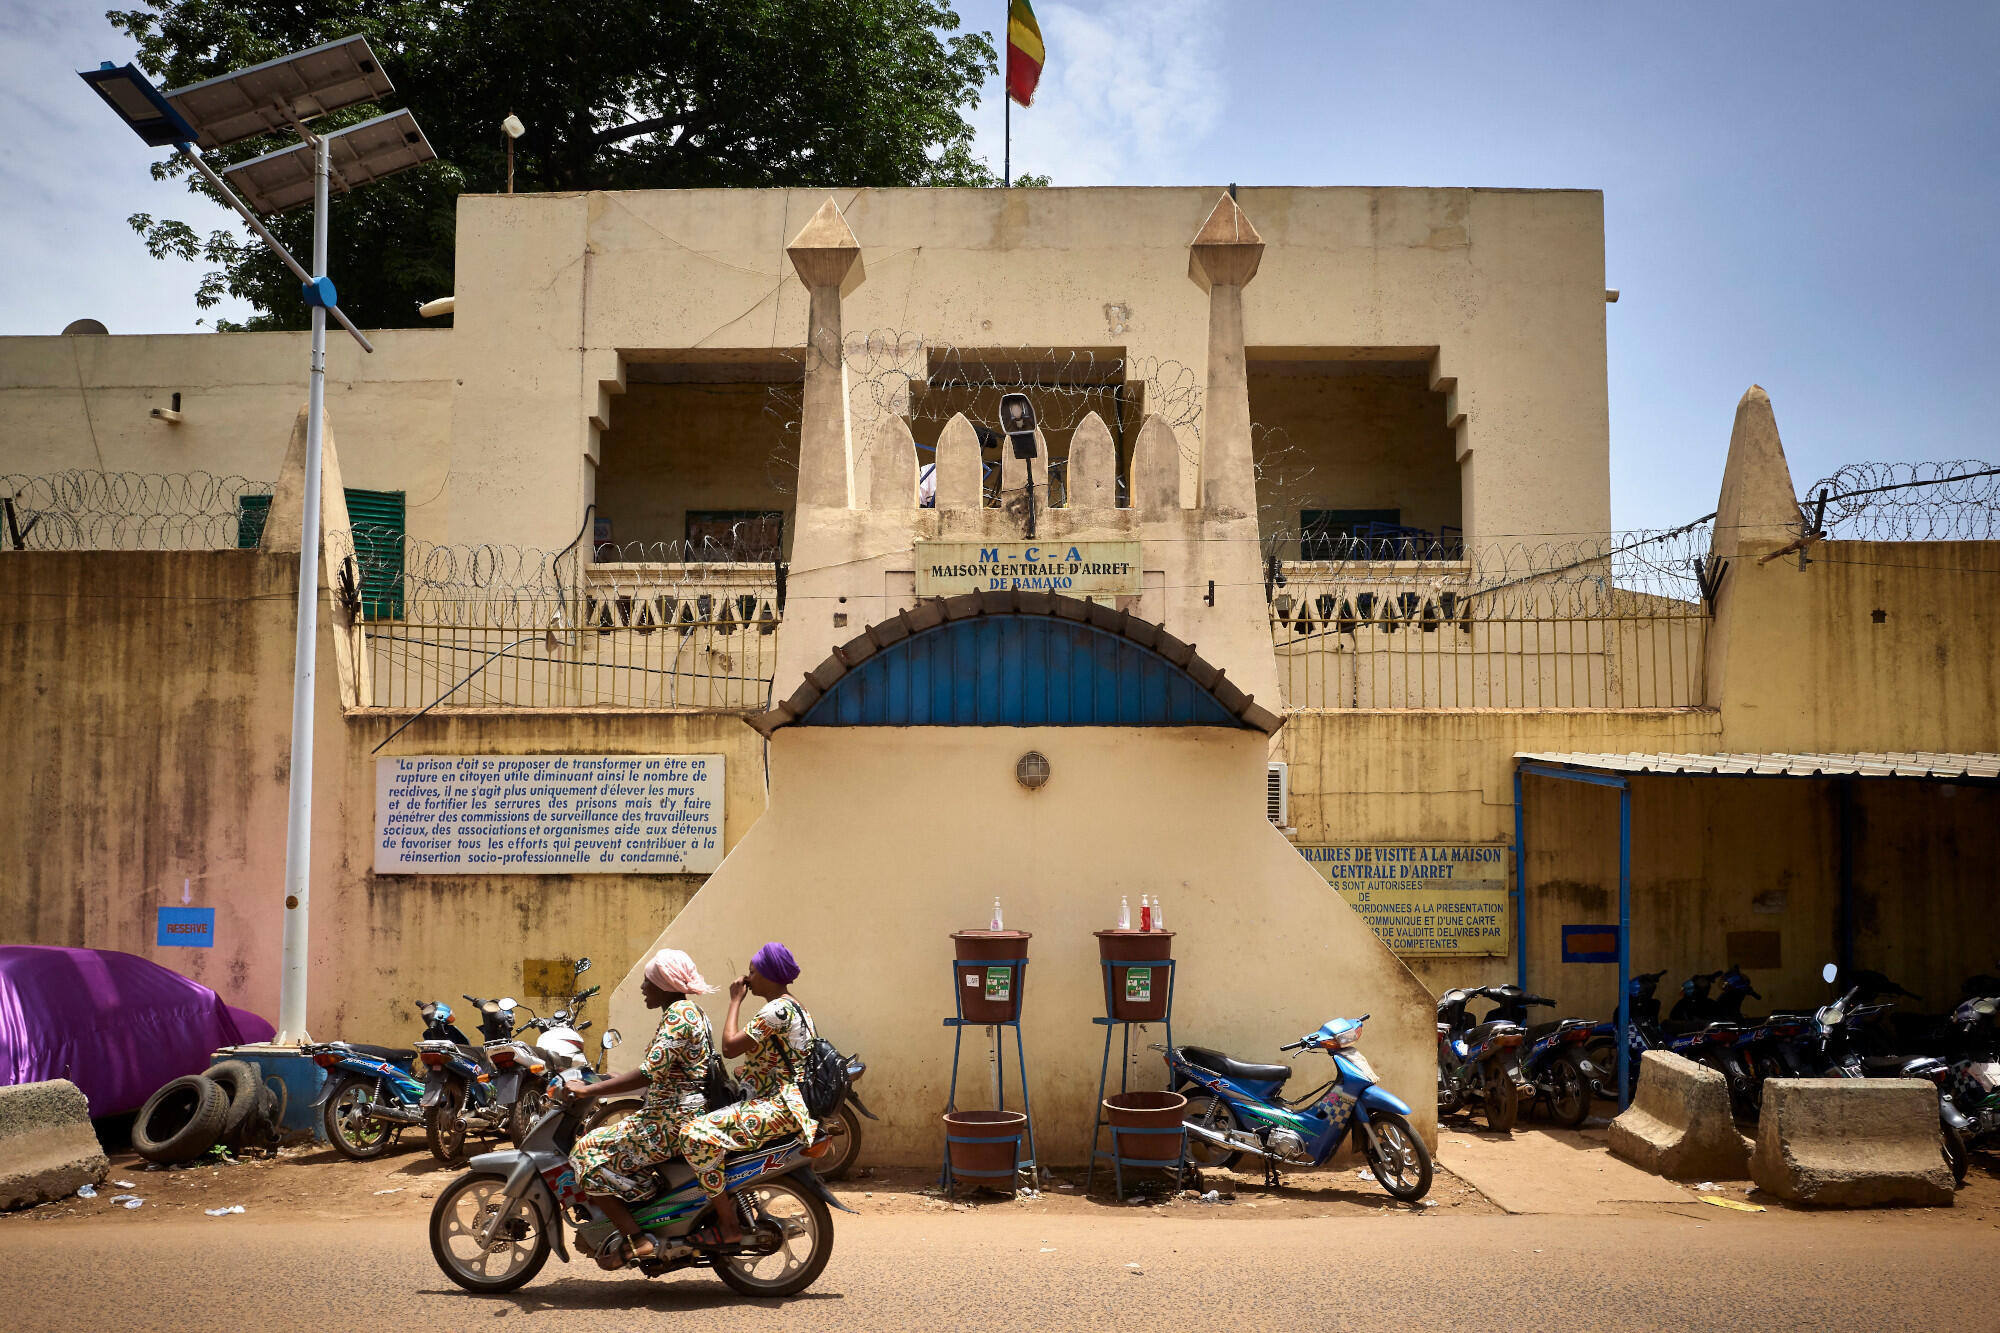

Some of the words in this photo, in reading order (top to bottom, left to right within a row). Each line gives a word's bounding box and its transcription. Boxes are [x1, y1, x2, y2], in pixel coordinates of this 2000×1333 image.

[932, 565, 987, 577] MAISON
[991, 563, 1065, 576] CENTRALE
[1068, 562, 1130, 575] D'ARRET
[989, 578, 1007, 590] DE
[1012, 576, 1073, 589] BAMAKO
[417, 759, 452, 772] prison
[457, 758, 479, 769] doit
[482, 761, 494, 769] se
[498, 761, 550, 772] proposer
[554, 757, 569, 769] de
[573, 758, 642, 769] transformer
[646, 760, 660, 769] un
[664, 757, 687, 769] être
[691, 760, 705, 769] en
[396, 773, 438, 785] rupture
[442, 773, 456, 782] en
[459, 770, 500, 784] citoyen
[504, 771, 530, 781] utile
[533, 770, 593, 781] diminuant
[597, 770, 625, 781] ainsi
[629, 770, 639, 781] le
[643, 770, 688, 781] nombre
[692, 770, 707, 781] de
[389, 785, 440, 798] recidives,
[444, 785, 452, 796] il
[454, 788, 468, 796] ne
[471, 785, 501, 799] s'agit
[503, 784, 526, 799] plus
[530, 784, 597, 798] uniquement
[600, 784, 645, 795] d'élever
[648, 784, 664, 795] les
[667, 787, 694, 795] murs
[388, 799, 400, 809] et
[406, 798, 421, 809] de
[424, 798, 467, 809] fortifier
[471, 797, 487, 809] les
[494, 800, 541, 809] serrures
[548, 797, 568, 808] des
[575, 797, 617, 811] prisons
[625, 797, 652, 808] mais
[684, 797, 711, 808] faire
[388, 811, 435, 825] pénétrer
[438, 810, 458, 822] des
[461, 811, 529, 822] commissions
[533, 810, 547, 821] de
[550, 809, 618, 821] surveillance
[622, 809, 641, 821] des
[645, 809, 709, 821] travailleurs
[383, 824, 429, 837] sociaux,
[431, 823, 451, 835] des
[457, 824, 527, 835] associations
[529, 825, 540, 835] et
[543, 824, 609, 837] organismes
[614, 823, 640, 835] aide
[646, 826, 667, 835] aux
[671, 823, 717, 834] détenus
[382, 837, 396, 848] de
[401, 837, 451, 848] favoriser
[457, 839, 481, 849] tous
[488, 837, 503, 849] les
[507, 837, 548, 849] efforts
[553, 838, 571, 852] qui
[626, 837, 686, 849] contribuer
[691, 838, 698, 848] à
[703, 837, 714, 849] la
[400, 851, 461, 862] réinsertion
[468, 850, 590, 865] socio-professionnelle
[599, 850, 614, 862] du
[1355, 848, 1371, 861] DE
[1375, 848, 1416, 861] VISITE
[1431, 848, 1447, 861] LA
[1451, 848, 1501, 862] MAISON
[1331, 865, 1396, 879] CENTRALE
[1400, 865, 1453, 878] D'ARRET
[1342, 881, 1365, 890] SONT
[1368, 880, 1423, 890] AUTORISEES
[1358, 892, 1370, 901] DE
[1414, 904, 1420, 912] A
[1423, 904, 1434, 912] LA
[1436, 904, 1504, 912] PRESENTATION
[1424, 916, 1435, 925] ET
[1437, 916, 1463, 925] D'UNE
[1466, 916, 1496, 925] CARTE
[167, 923, 208, 934] RESERVE
[1382, 928, 1394, 936] DE
[1396, 928, 1434, 936] VALIDITE
[1437, 928, 1480, 936] DELIVRES
[1482, 928, 1501, 936] PAR
[1394, 939, 1458, 948] COMPETENTES
